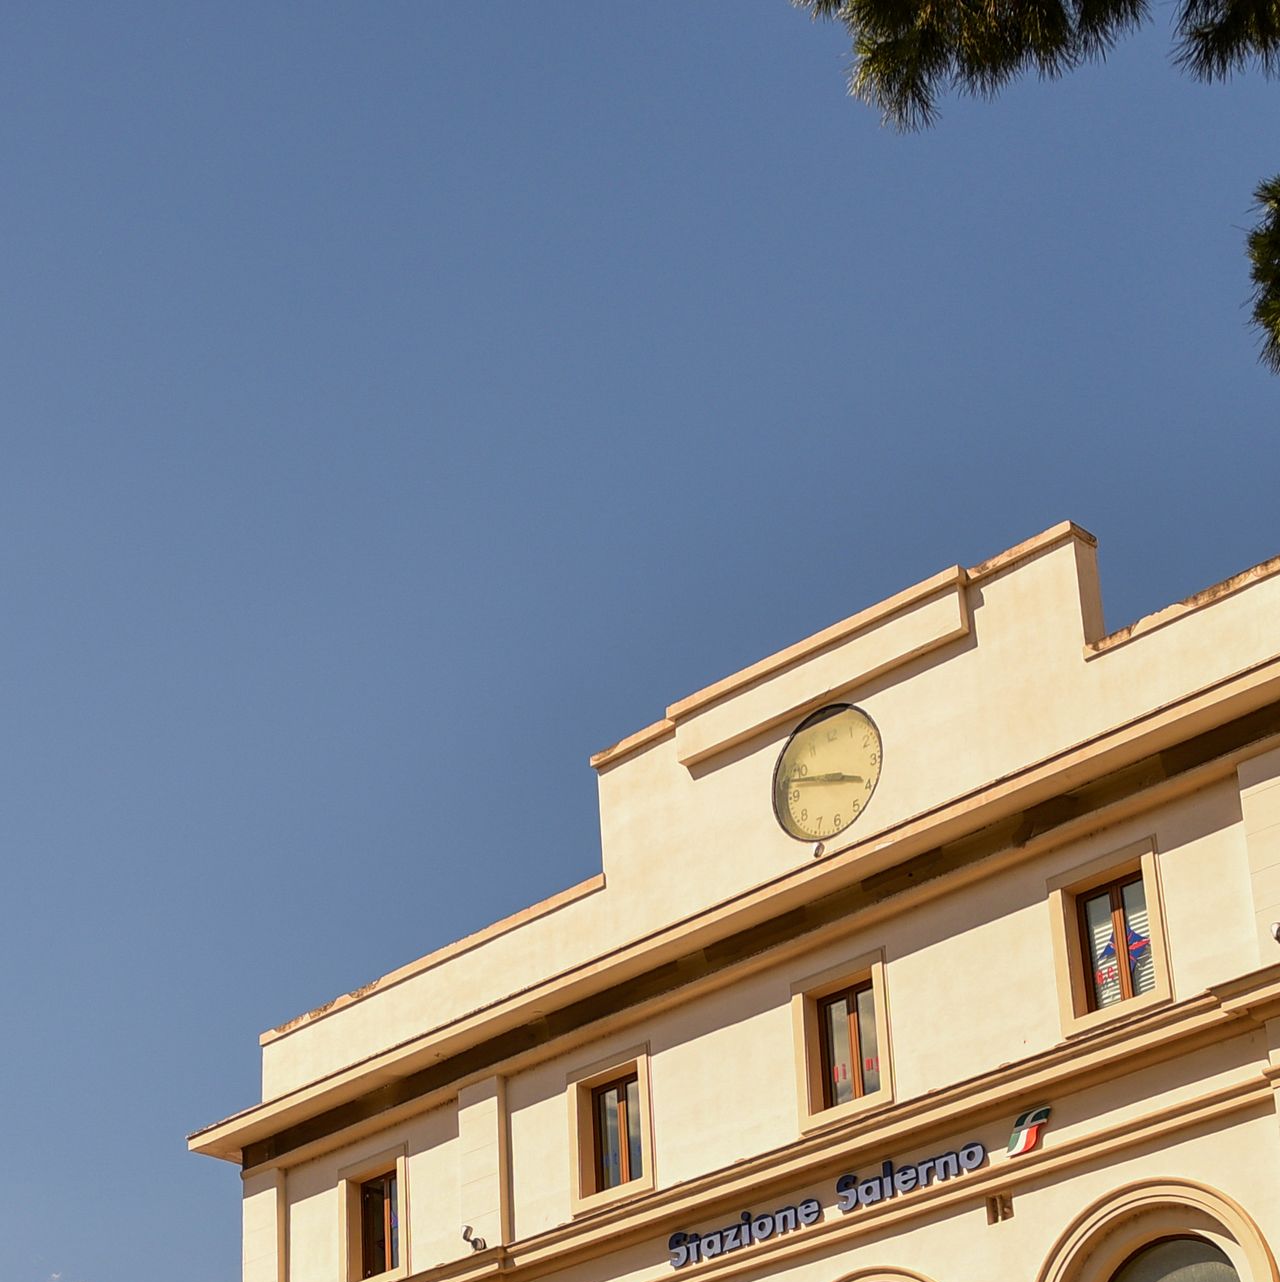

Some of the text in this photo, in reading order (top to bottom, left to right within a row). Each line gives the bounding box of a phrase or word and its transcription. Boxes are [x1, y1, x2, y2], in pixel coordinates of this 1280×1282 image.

[862, 734, 870, 750] 2
[870, 752, 878, 767] 3
[864, 777, 873, 792] 4
[792, 789, 800, 803] 9
[852, 799, 861, 814] 5
[800, 808, 808, 822] 8
[816, 815, 824, 830] 7
[833, 813, 842, 828] 6
[669, 1142, 986, 1268] Stazione Salerno
